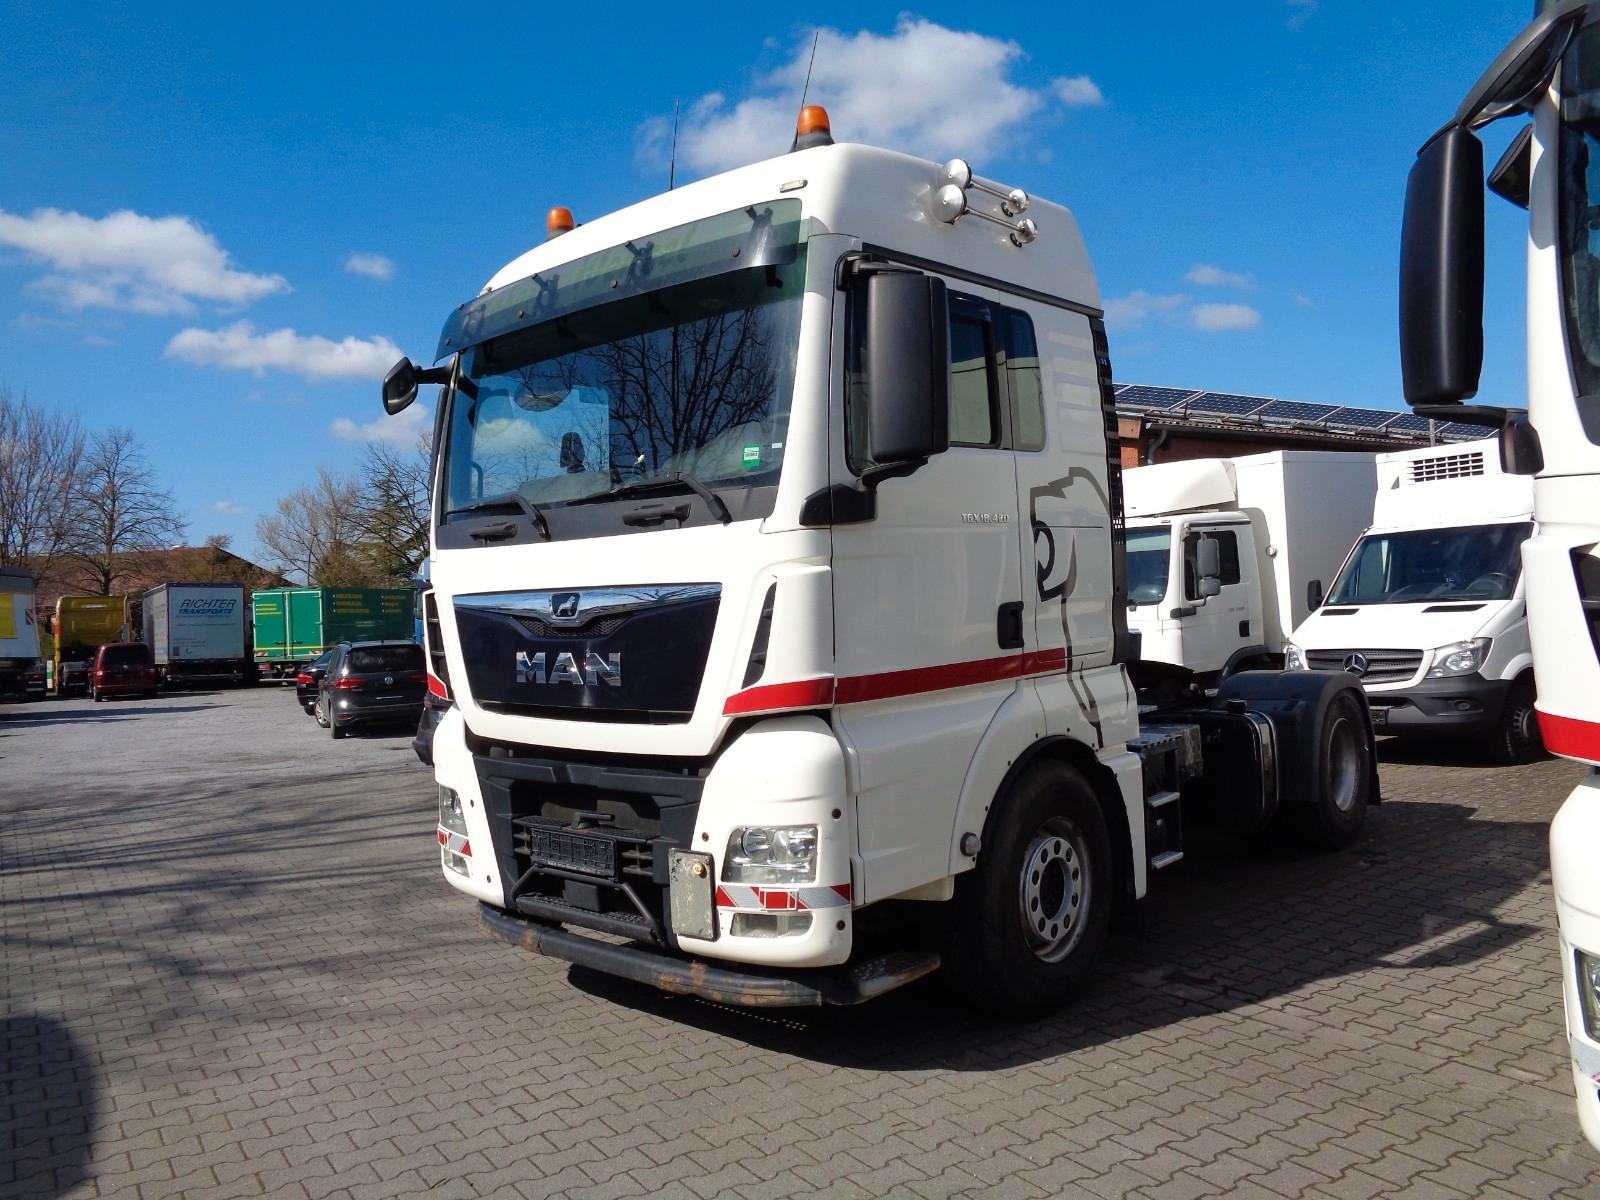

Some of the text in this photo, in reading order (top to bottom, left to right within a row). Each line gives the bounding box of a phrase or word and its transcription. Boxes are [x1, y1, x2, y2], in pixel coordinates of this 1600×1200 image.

[961, 513, 979, 523] TGX
[180, 598, 237, 609] RICHTER
[516, 651, 621, 686] MAN
